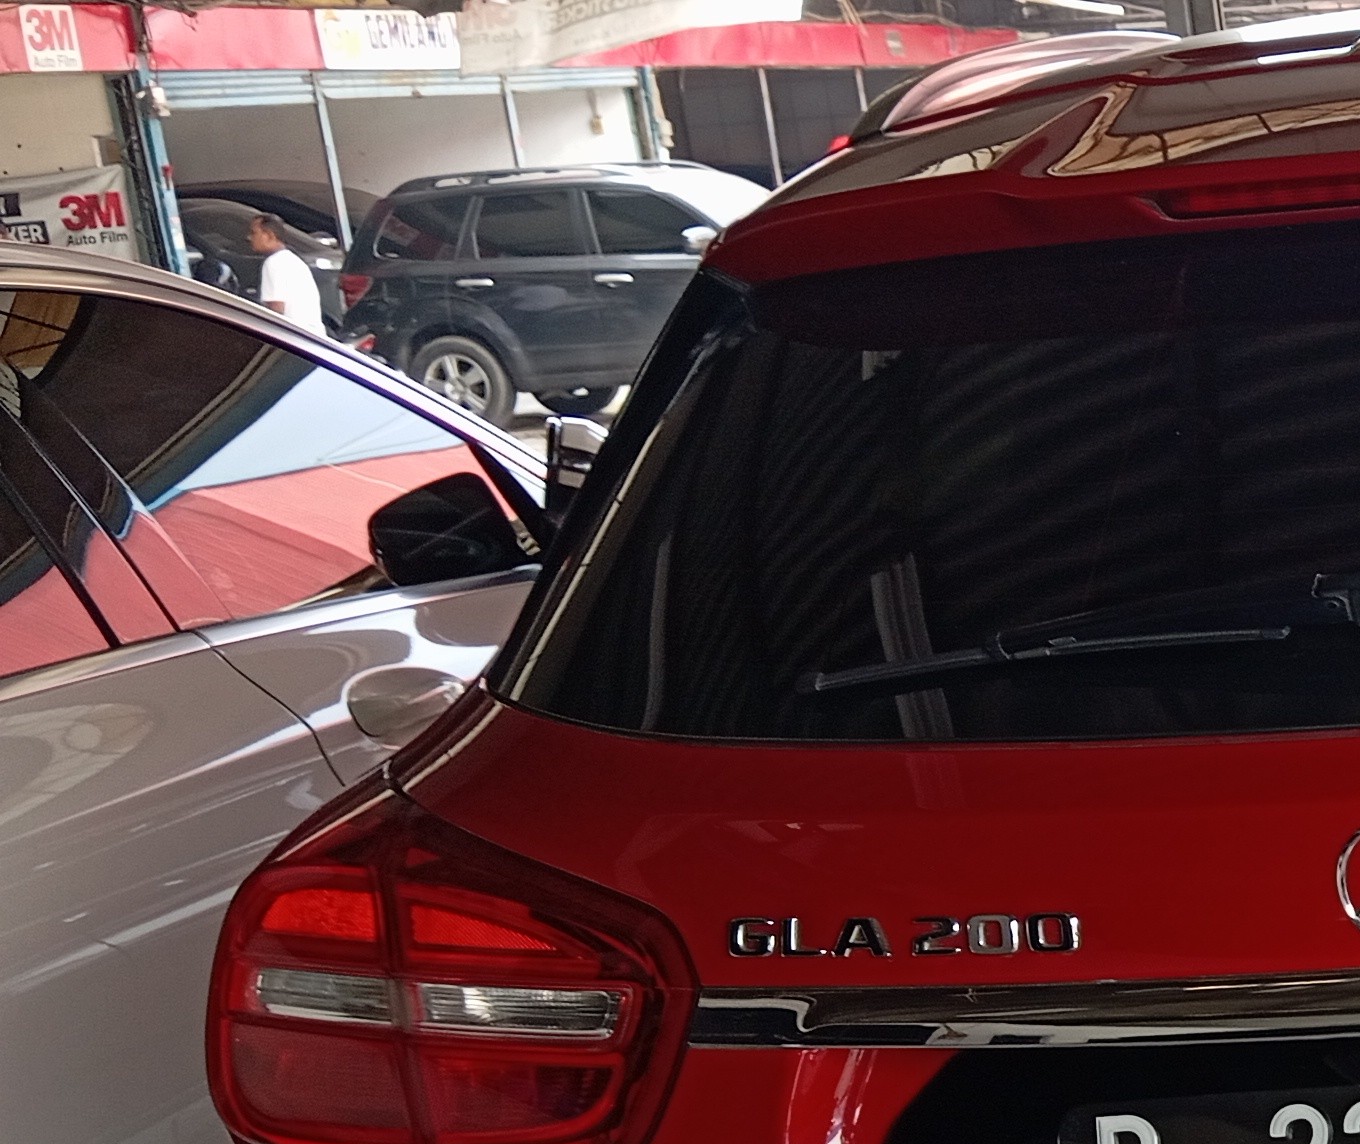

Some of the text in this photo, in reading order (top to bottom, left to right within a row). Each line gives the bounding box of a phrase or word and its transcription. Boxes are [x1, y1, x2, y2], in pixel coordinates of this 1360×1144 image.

[26, 9, 75, 51] 3M
[59, 191, 126, 231] 3M
[67, 230, 129, 246] Auto Film
[728, 911, 1081, 957] GLA 200
